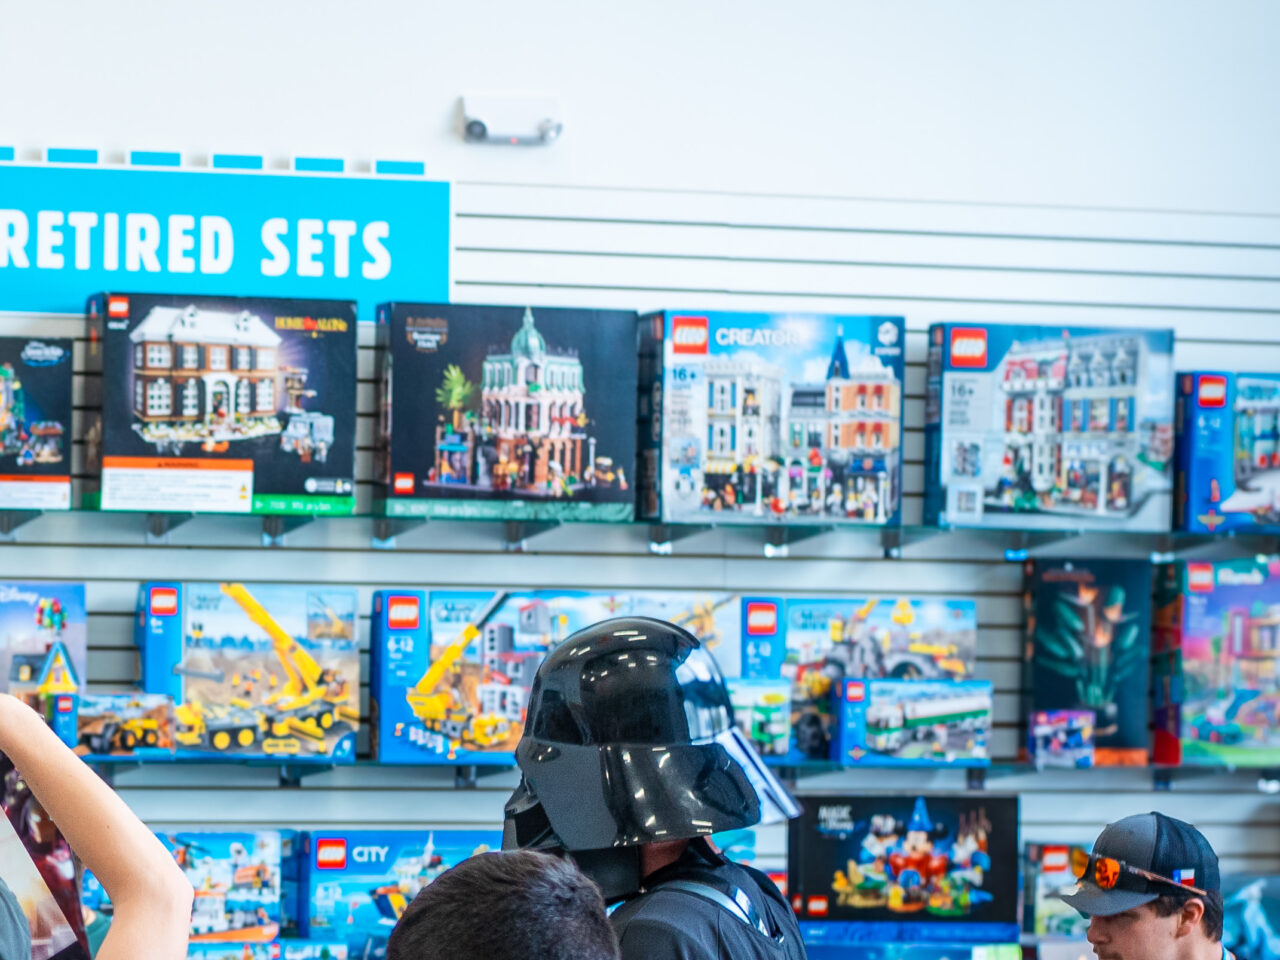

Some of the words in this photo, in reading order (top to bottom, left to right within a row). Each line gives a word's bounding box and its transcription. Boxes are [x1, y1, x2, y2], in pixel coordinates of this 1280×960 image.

[260, 218, 392, 279] SETS
[715, 328, 801, 346] CREATOR
[352, 846, 389, 862] CITY
